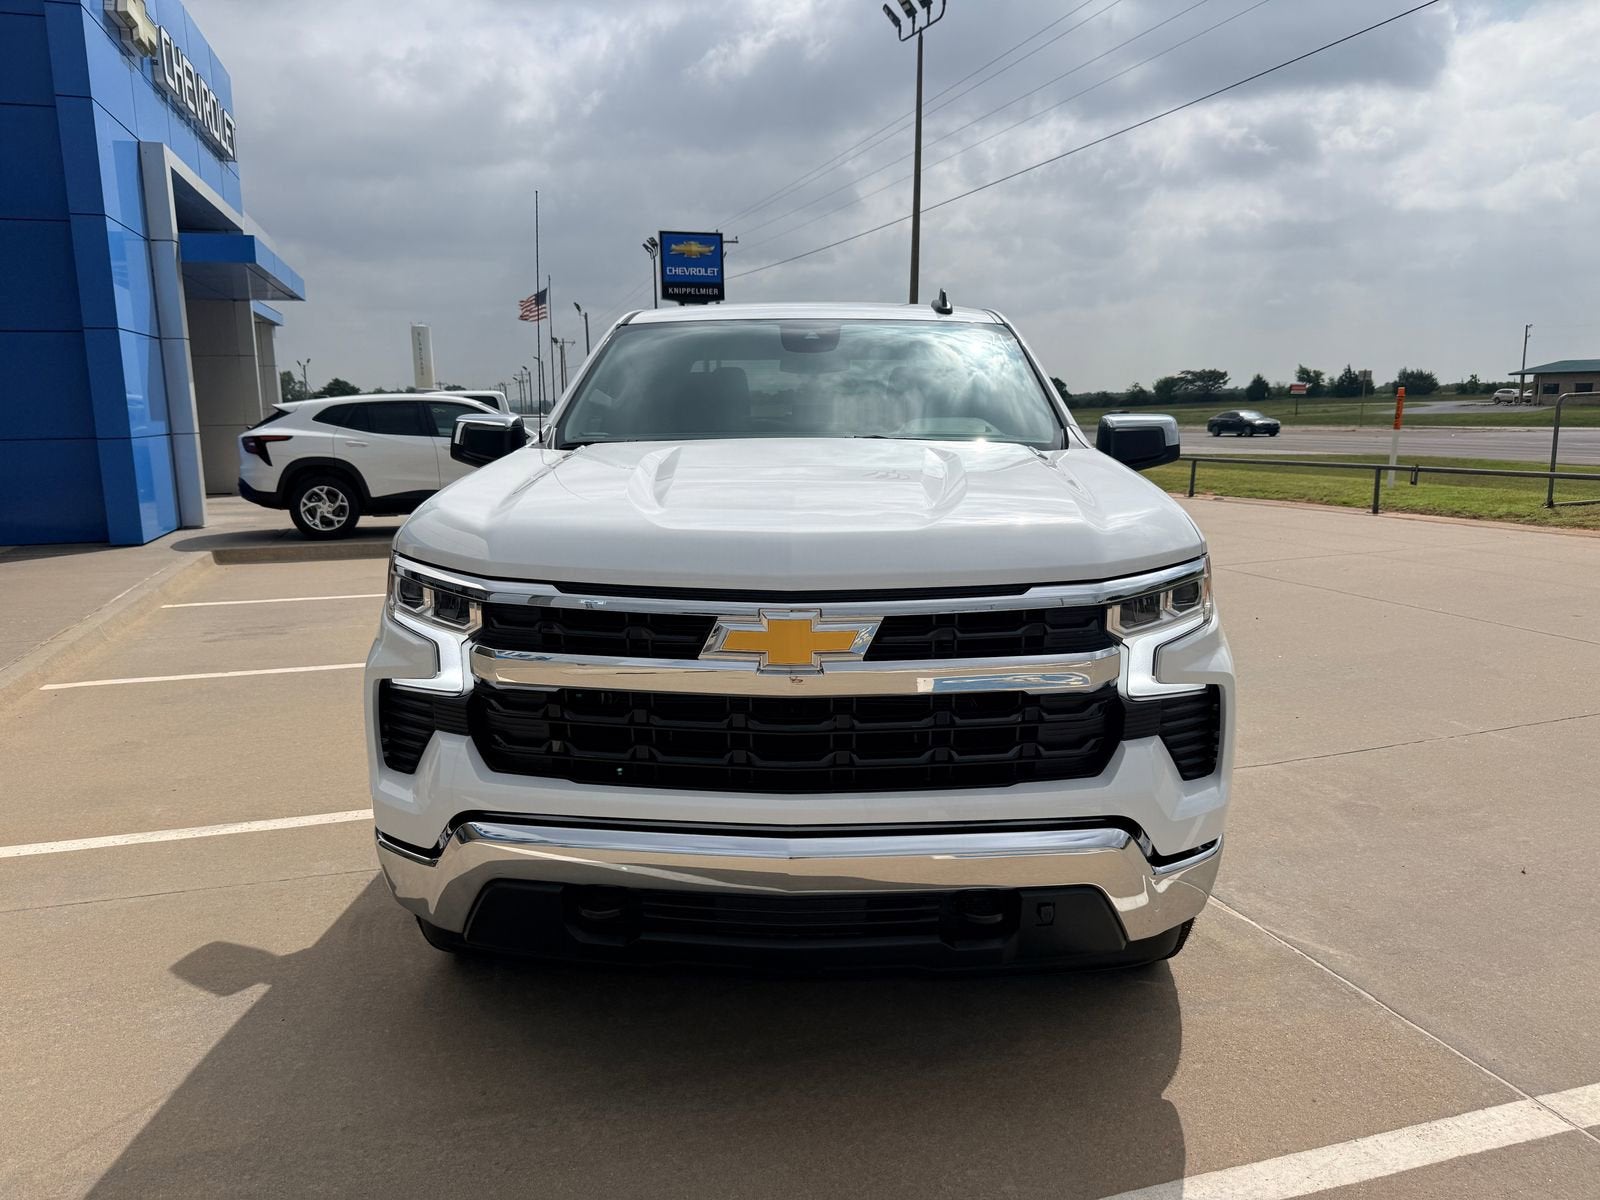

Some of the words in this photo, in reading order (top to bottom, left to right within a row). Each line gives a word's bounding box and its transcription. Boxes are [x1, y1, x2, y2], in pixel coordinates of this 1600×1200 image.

[159, 25, 237, 160] CHEVROLET
[666, 266, 719, 276] CHEVROLET
[668, 287, 719, 295] KNIPPELMIER
